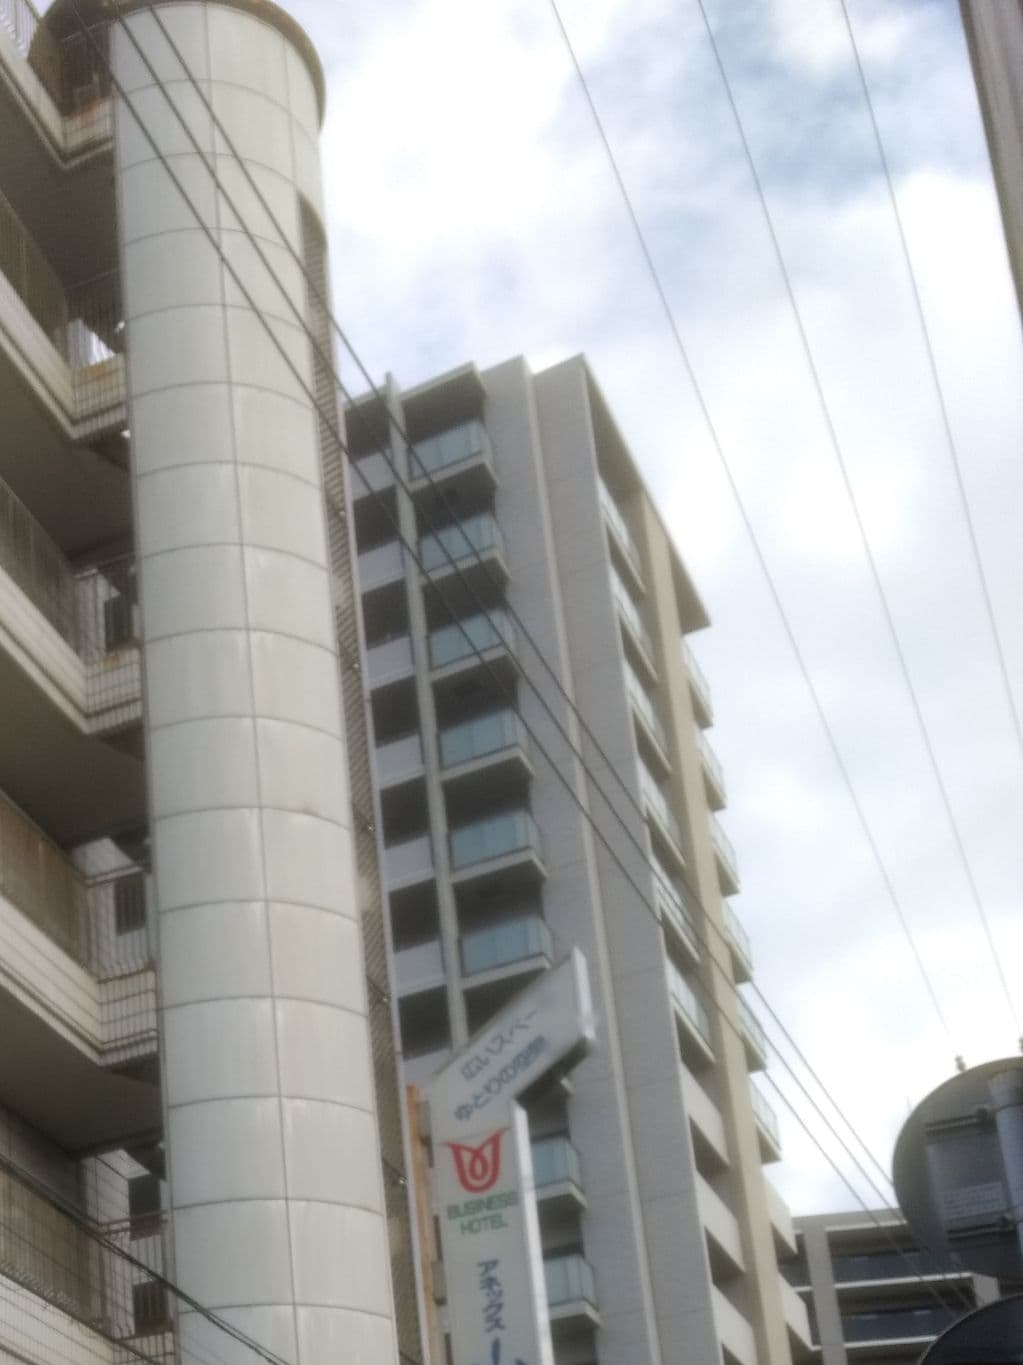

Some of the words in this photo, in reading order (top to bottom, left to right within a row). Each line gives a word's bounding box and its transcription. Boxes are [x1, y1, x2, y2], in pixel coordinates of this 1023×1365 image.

[447, 1190, 520, 1221] BUSINESS
[460, 1213, 508, 1236] HOTEL
[477, 1258, 505, 1333] アネックス
